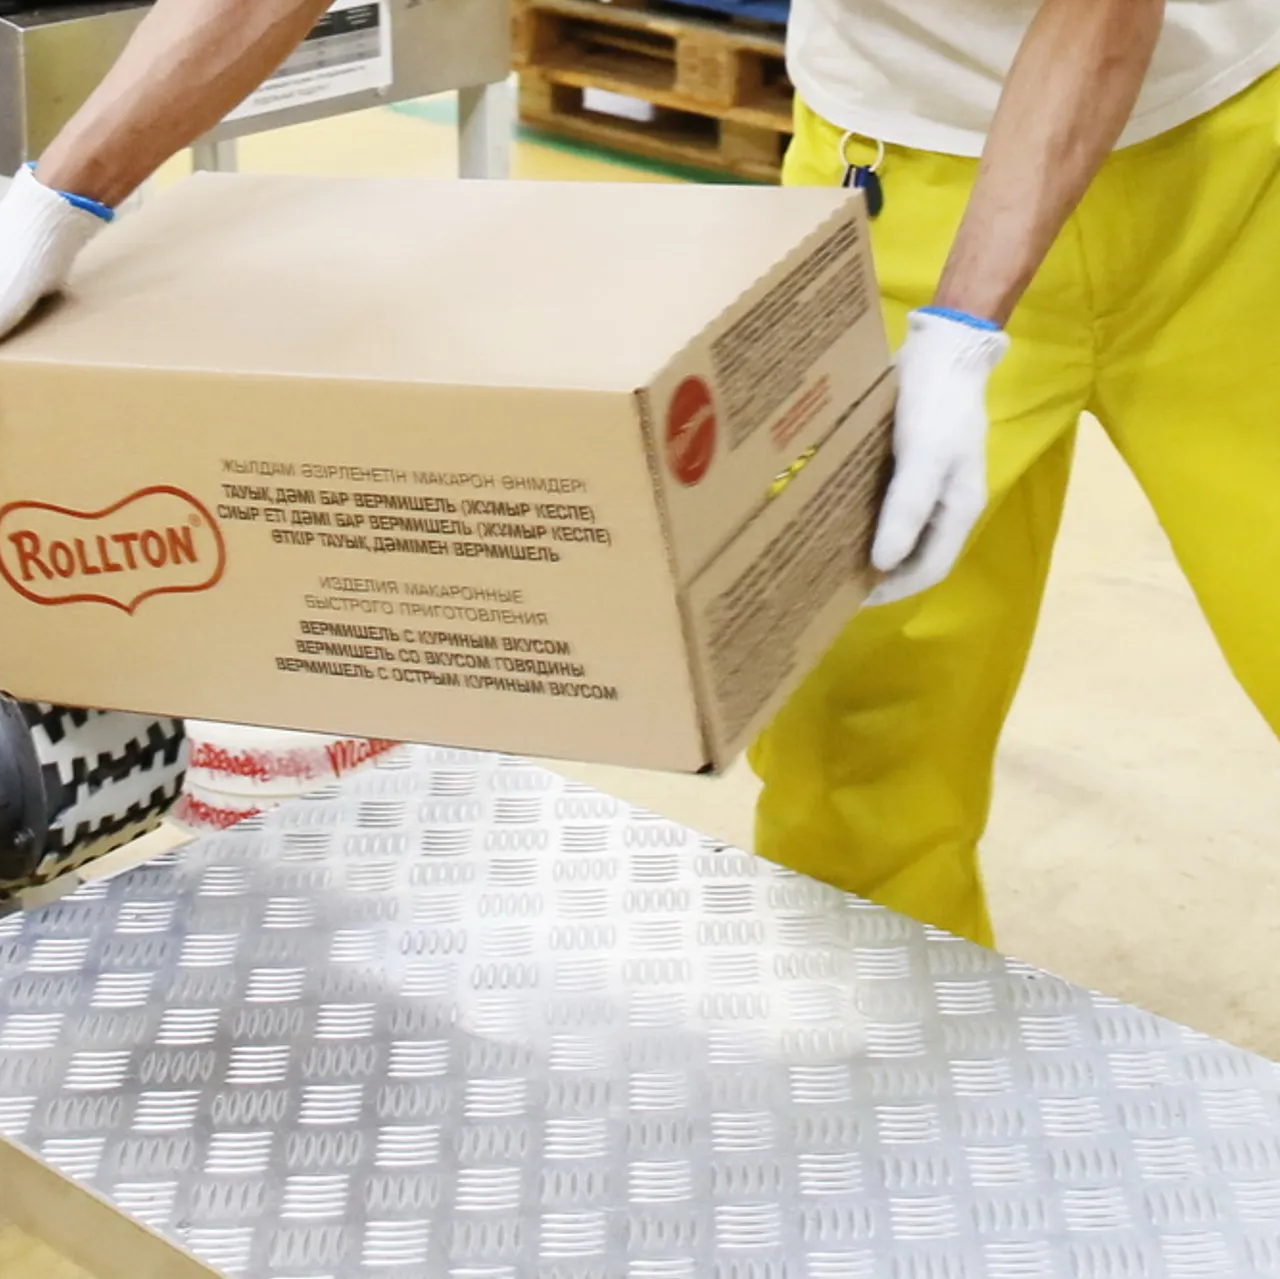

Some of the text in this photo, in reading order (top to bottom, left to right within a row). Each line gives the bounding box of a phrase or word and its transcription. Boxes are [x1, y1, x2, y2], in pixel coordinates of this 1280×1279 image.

[221, 458, 295, 477] ЖЫЛДАМ
[413, 471, 495, 489] МАКАРОН
[320, 491, 349, 506] БАР
[353, 493, 457, 514] ВЕРМИШЕЛЬ
[534, 504, 596, 524] КЕСПЕ)
[217, 504, 260, 520] СИЫР
[336, 513, 365, 528] БАР
[370, 515, 473, 536] ВЕРМИШЕЛЬ
[551, 526, 613, 547] КЕСПЕ)
[451, 542, 560, 562] ВЕРМИШЕЛЬ
[319, 576, 524, 604] ИЗДЕЛИЯ МАКАРОННЫЕ
[303, 594, 549, 626] БЫСТРОГО ПРИГОТОВЛЕНИЯ
[299, 620, 570, 655] ВЕРМИШЕЛЬ С КУРИНЫМ ВКУСОМ
[295, 640, 585, 677] ВЕРМИШЕЛЬ СО ВКУСОМ ГОВЯДИНЫ
[275, 657, 619, 701] ВЕРМИШЕЛЬ С ОСТРЫМ КУРИНЫМ ВКУСОМ
